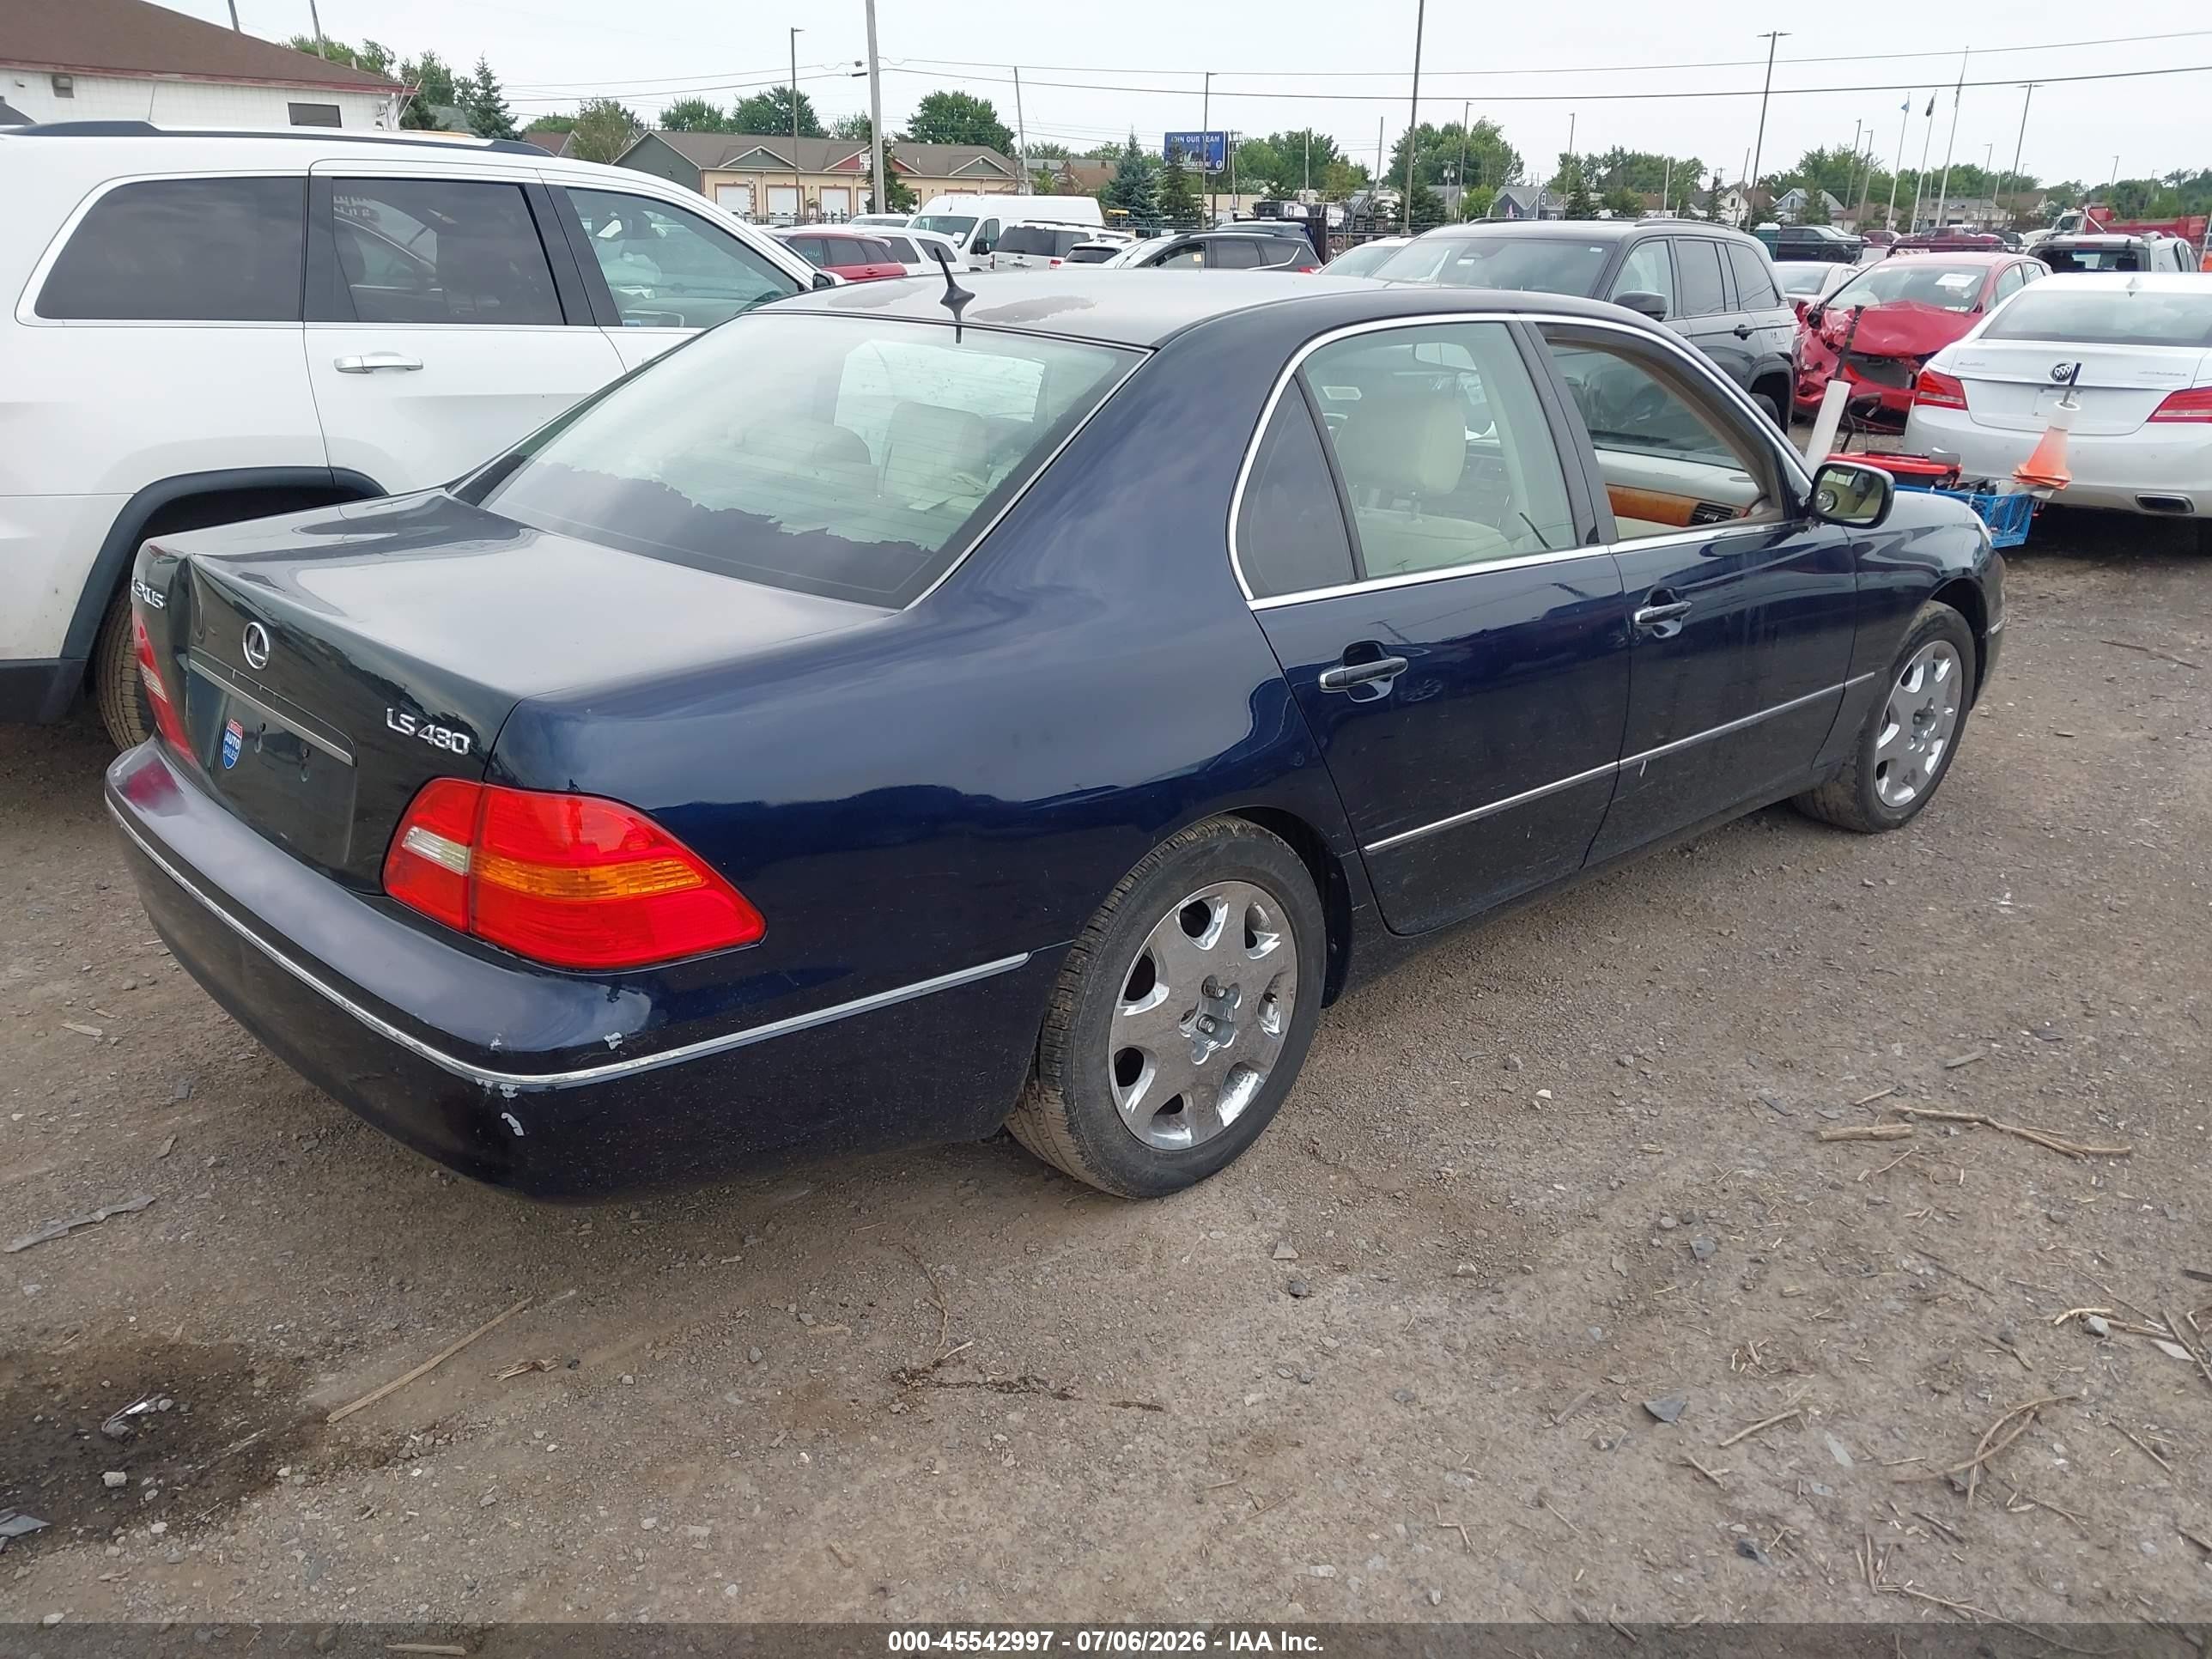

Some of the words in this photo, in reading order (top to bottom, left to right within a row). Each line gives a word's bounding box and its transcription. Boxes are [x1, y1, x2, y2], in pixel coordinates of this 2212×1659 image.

[1201, 135, 1220, 143] TEAM
[131, 577, 164, 610] LEXUS
[225, 731, 240, 750] AUTO
[386, 708, 416, 737] LS
[417, 724, 470, 756] 430
